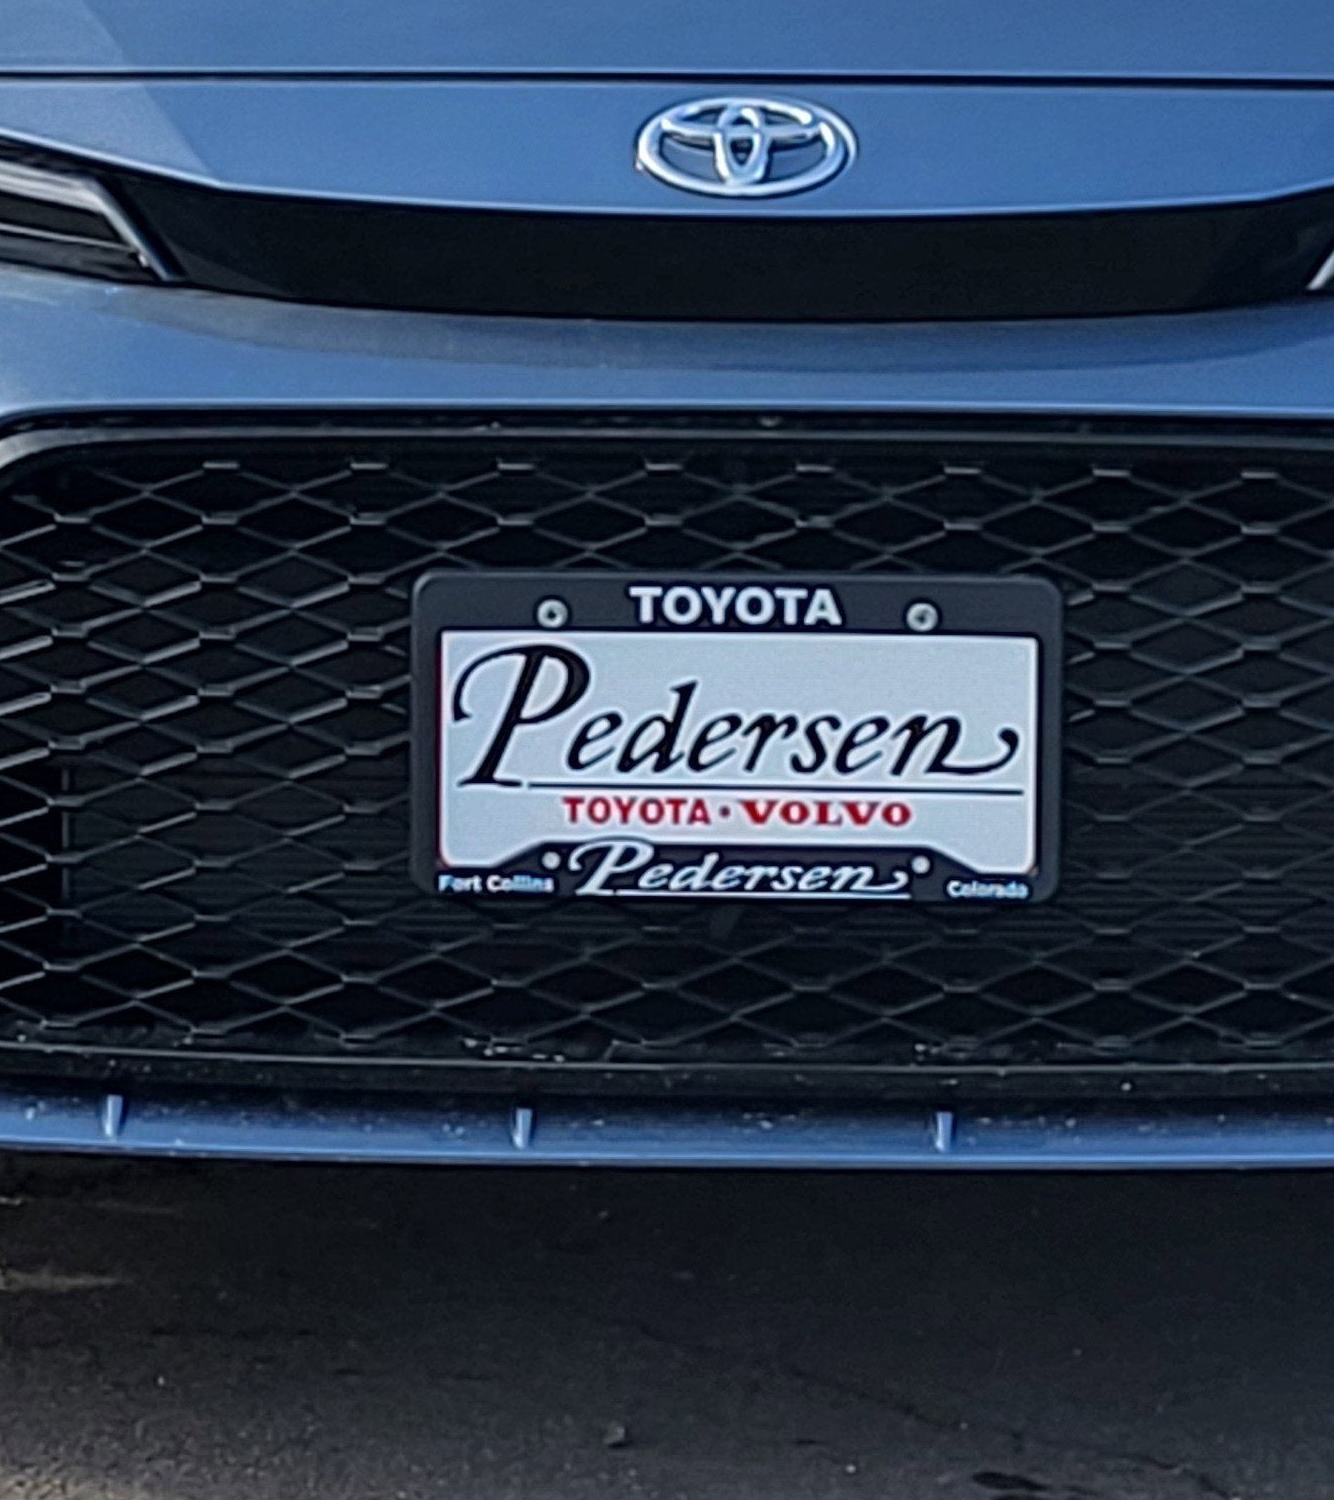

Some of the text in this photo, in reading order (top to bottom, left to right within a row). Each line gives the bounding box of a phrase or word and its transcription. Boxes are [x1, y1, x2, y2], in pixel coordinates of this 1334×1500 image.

[629, 586, 842, 626] TOYOTA
[452, 643, 1020, 787] Pedersen
[563, 796, 912, 828] TOYOTA VOLVO
[568, 839, 909, 896] Pedersen
[946, 879, 1030, 899] Colorado
